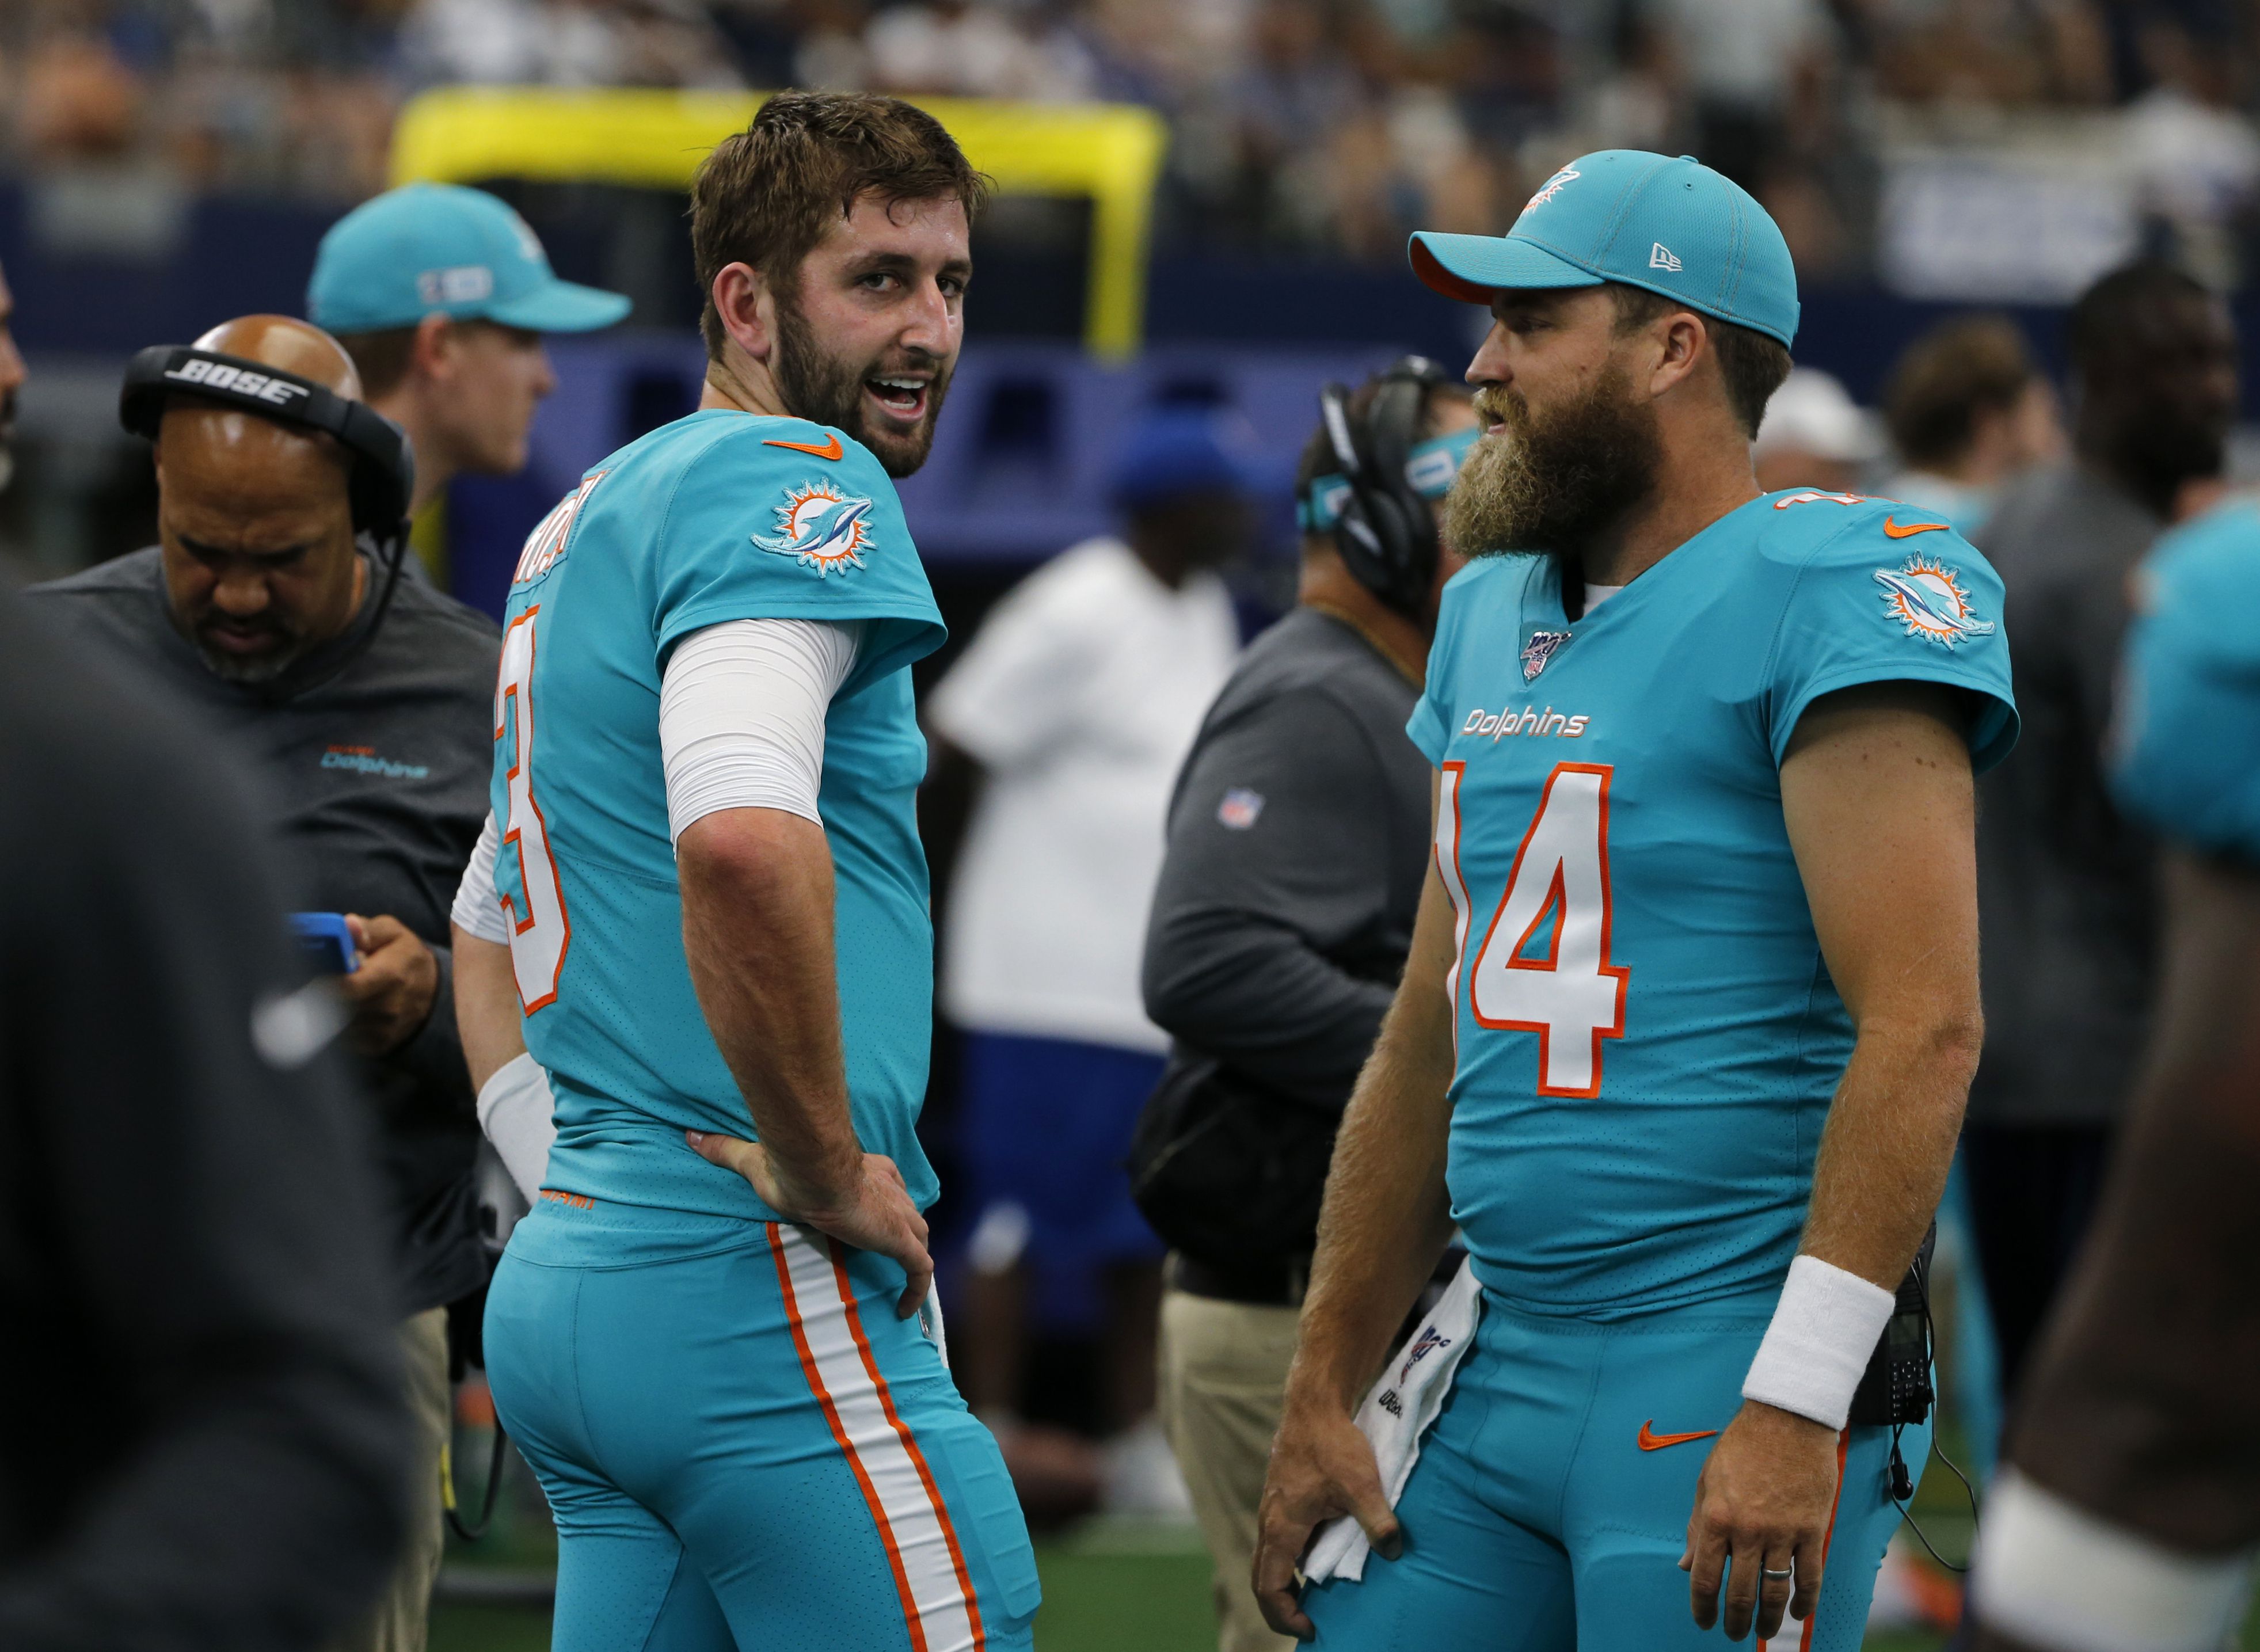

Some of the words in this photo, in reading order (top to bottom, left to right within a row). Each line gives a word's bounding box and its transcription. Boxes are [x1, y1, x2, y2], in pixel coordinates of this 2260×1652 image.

[164, 359, 310, 405] BOSE
[494, 603, 570, 1017] 3
[1461, 705, 1589, 743] Dolphins
[1435, 760, 1631, 1098] 14
